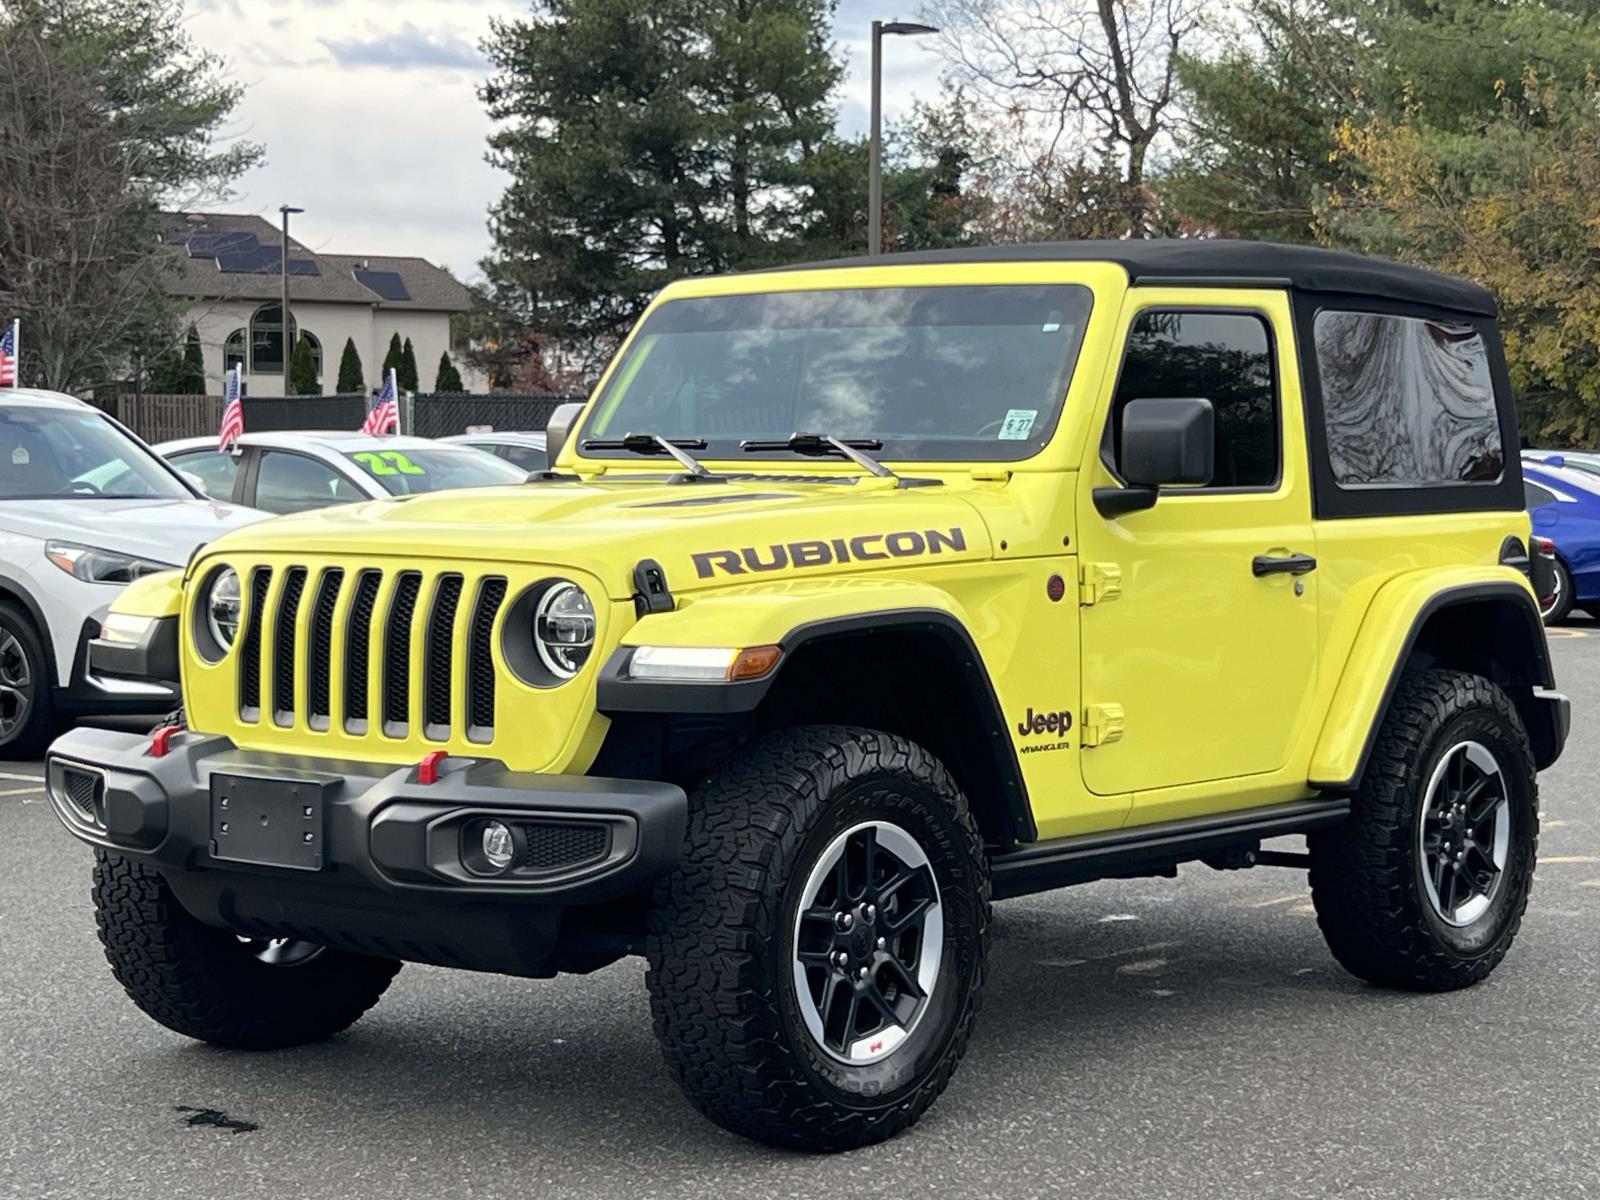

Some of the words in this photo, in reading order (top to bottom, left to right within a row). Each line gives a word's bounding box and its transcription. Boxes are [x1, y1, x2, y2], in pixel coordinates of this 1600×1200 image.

[1006, 419, 1015, 431] 6
[1016, 419, 1032, 432] 27
[353, 450, 426, 476] 22
[690, 527, 967, 579] RUBICON
[1018, 707, 1072, 737] Jeep
[1020, 742, 1070, 754] WRANGLER
